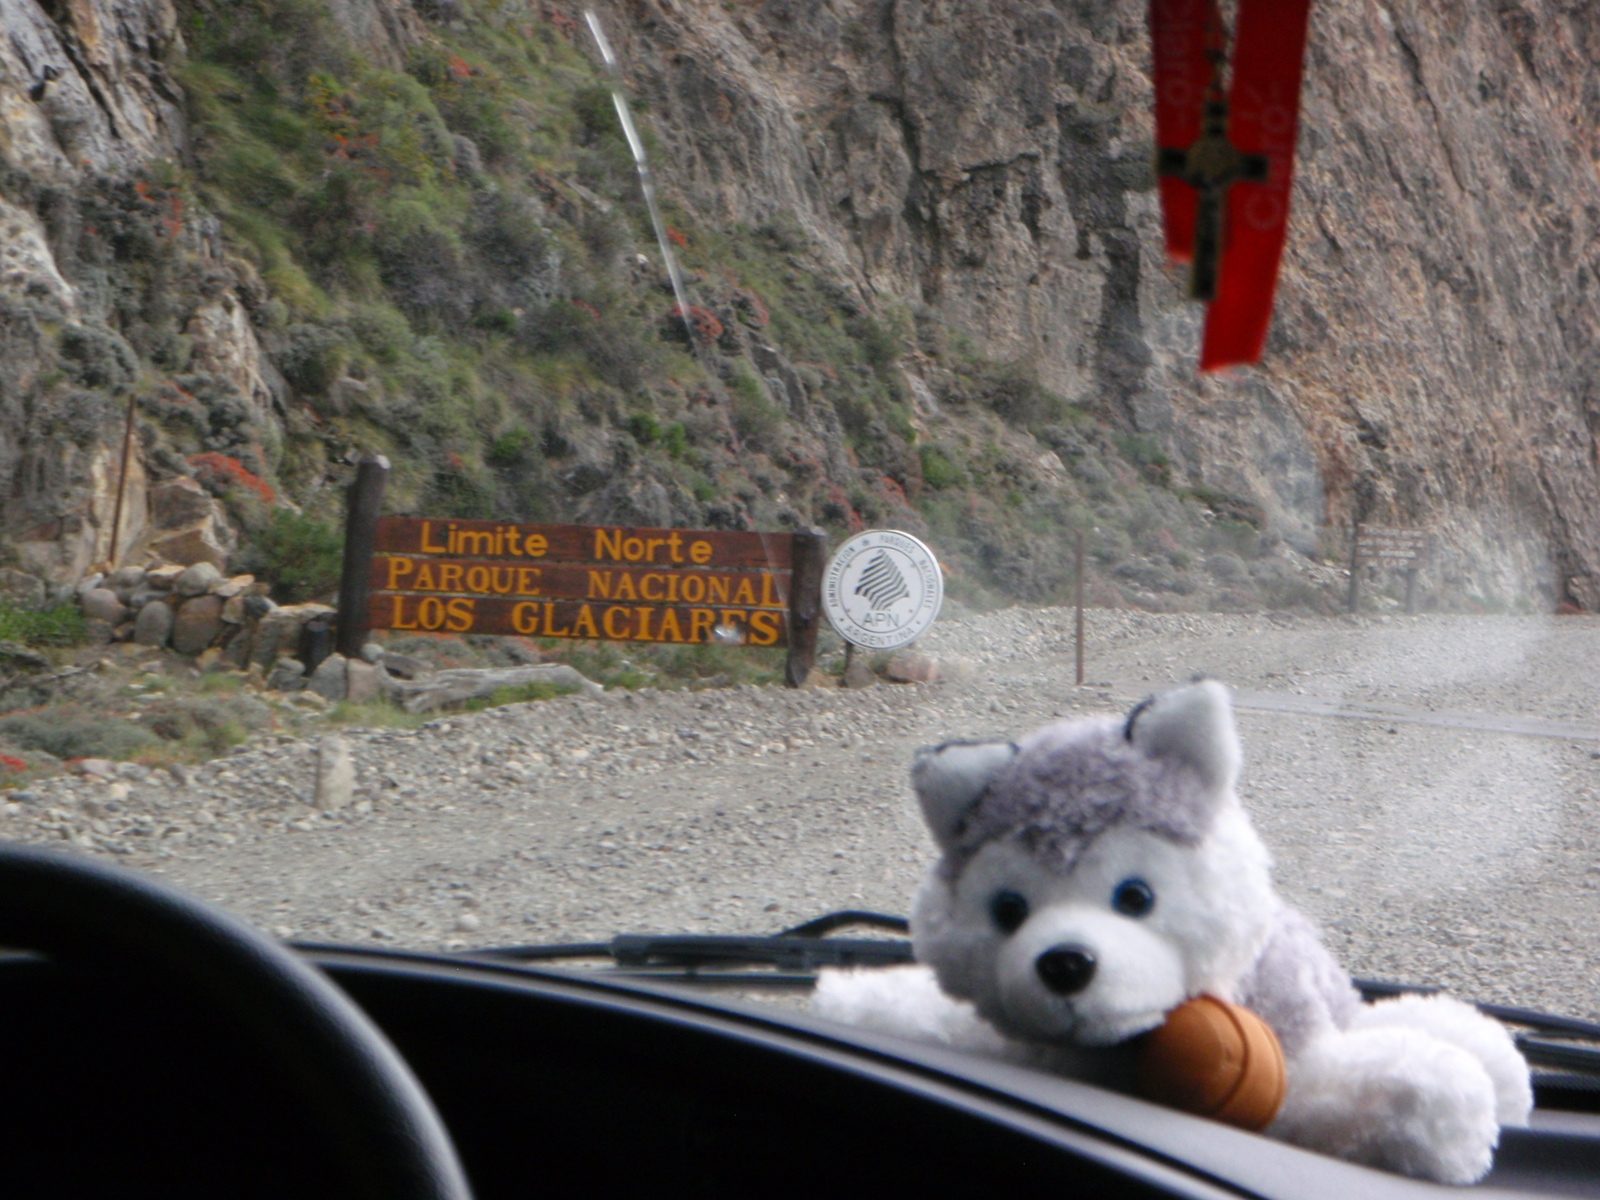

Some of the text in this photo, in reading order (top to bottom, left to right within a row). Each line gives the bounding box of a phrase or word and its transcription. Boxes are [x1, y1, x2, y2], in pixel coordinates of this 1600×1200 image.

[421, 521, 713, 564] Limite Norte
[384, 557, 785, 609] PARQUE NACIONAL
[391, 595, 781, 646] LOS GLACIARES
[862, 612, 899, 628] APN
